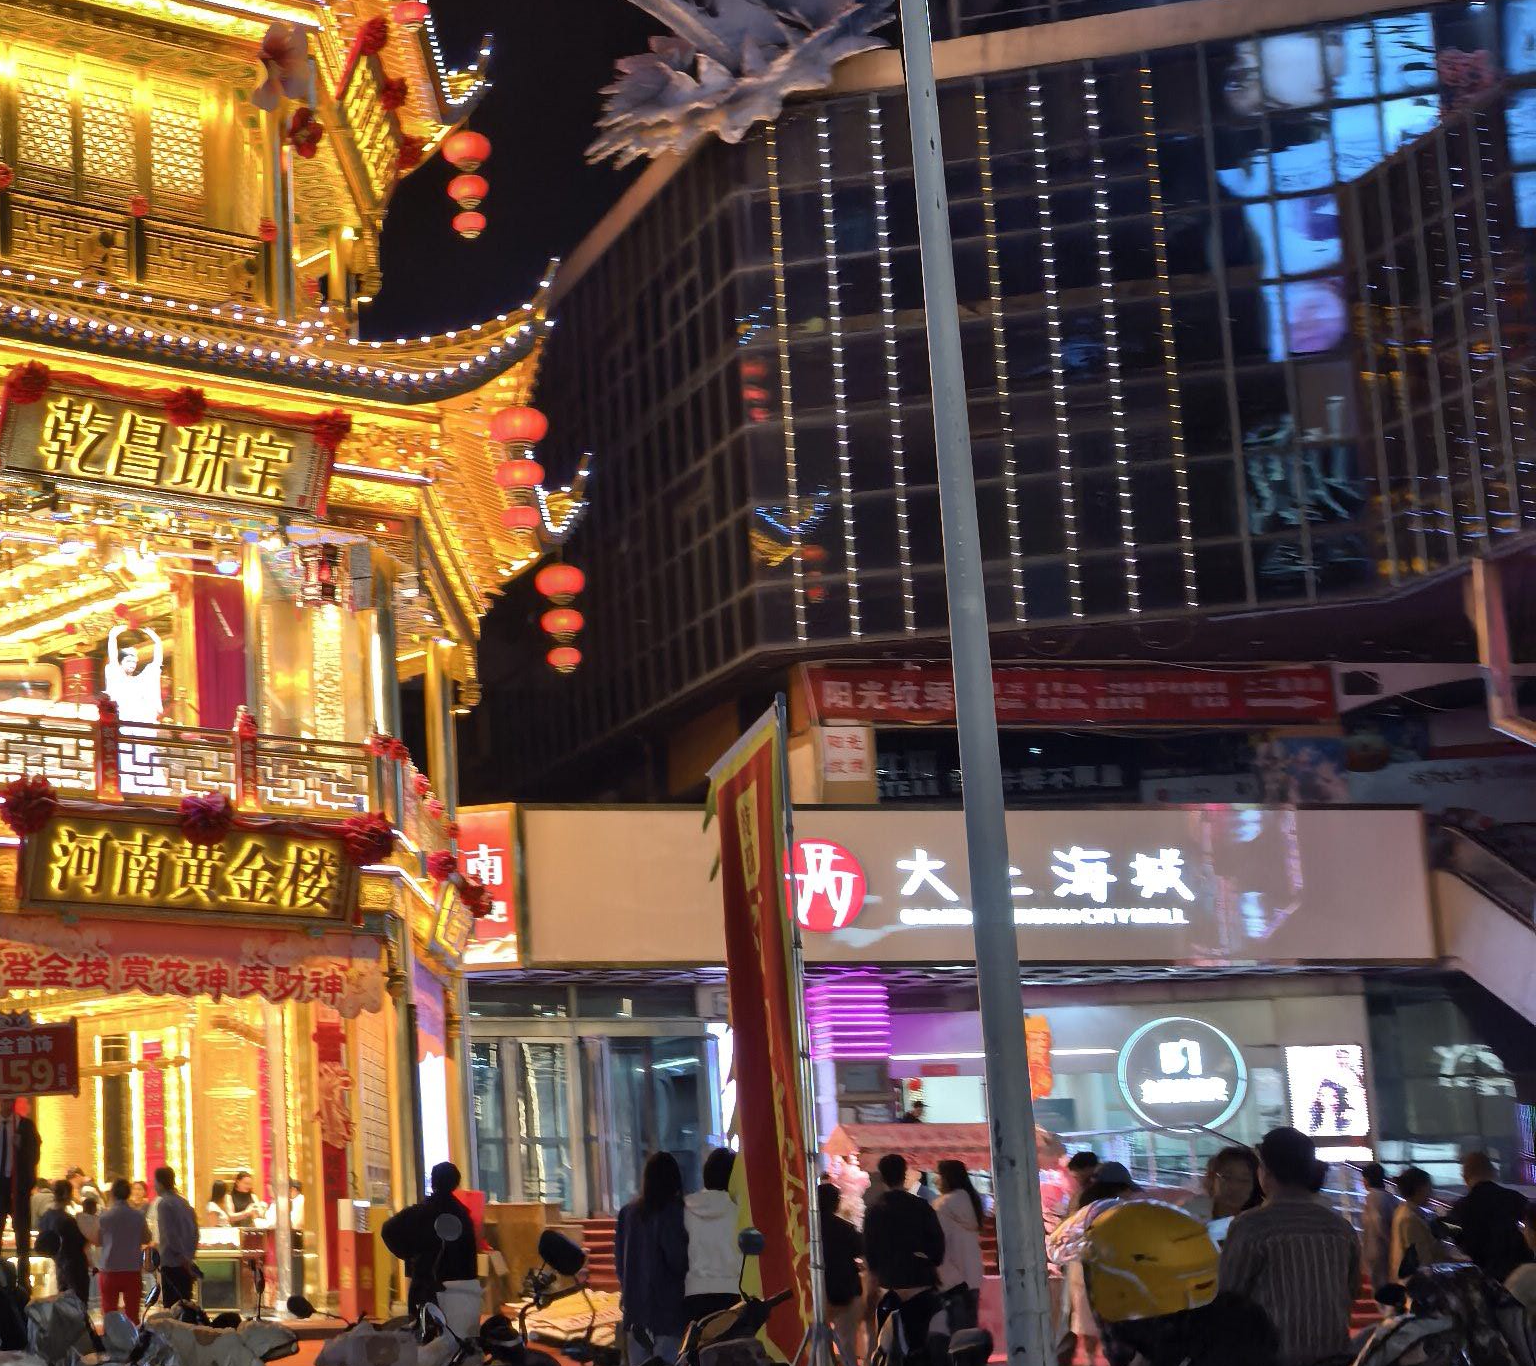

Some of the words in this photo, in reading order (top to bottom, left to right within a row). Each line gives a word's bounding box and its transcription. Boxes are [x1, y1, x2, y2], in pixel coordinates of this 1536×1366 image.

[38, 396, 294, 501] 乾昌珠宝
[50, 826, 340, 912] 河南黄金楼
[1, 950, 111, 990] 登金楼
[119, 955, 232, 1003] 赏花神
